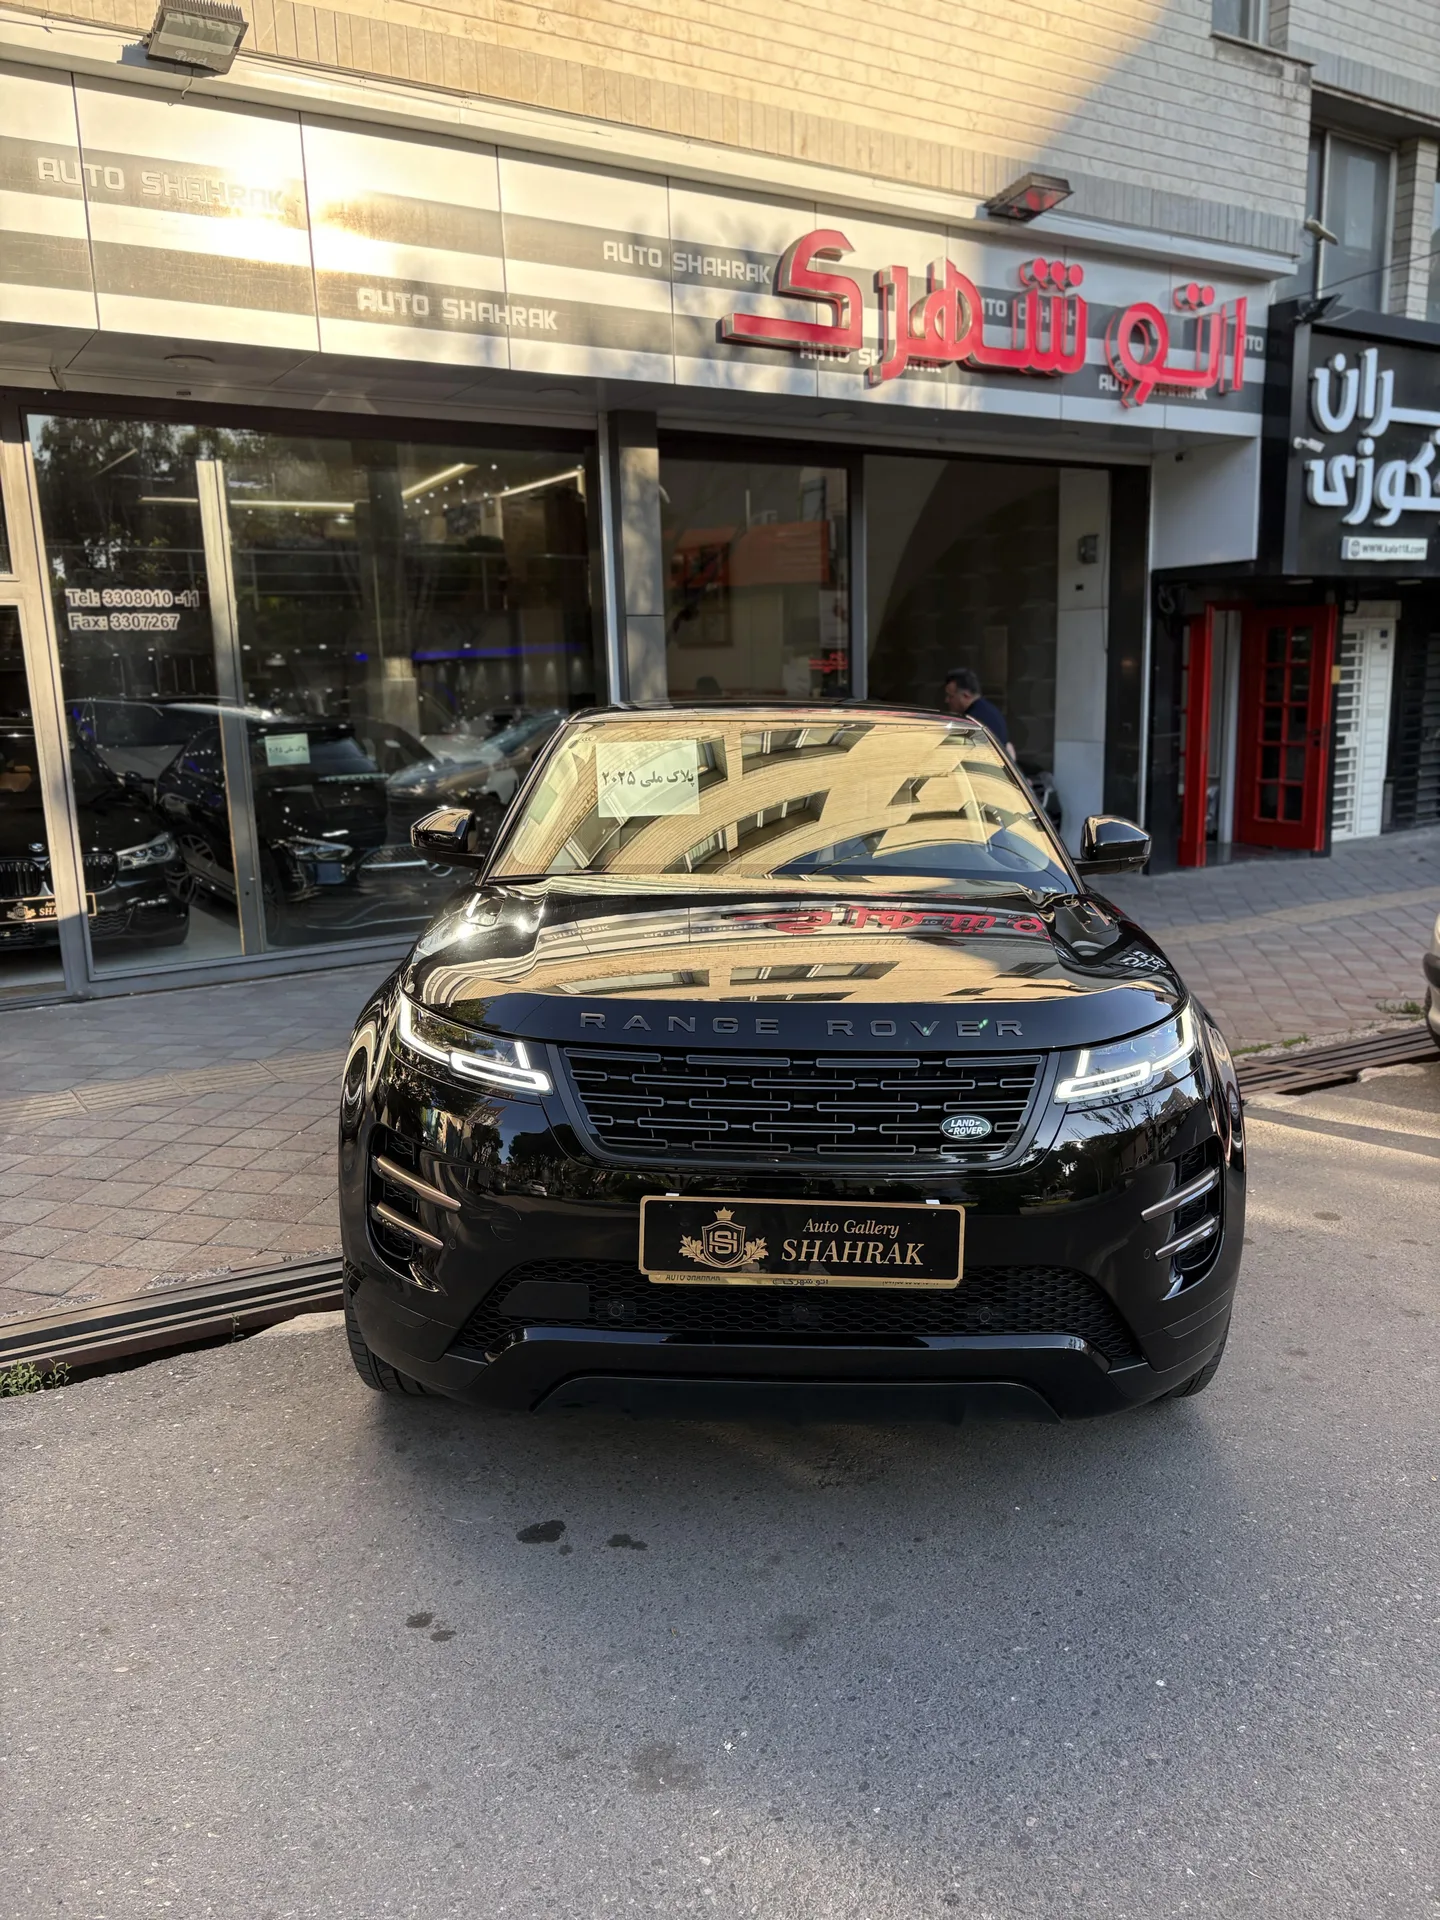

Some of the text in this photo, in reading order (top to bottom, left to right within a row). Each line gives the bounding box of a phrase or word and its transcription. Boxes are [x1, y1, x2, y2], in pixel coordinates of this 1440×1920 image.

[37, 156, 126, 191] AUTO
[602, 240, 772, 285] AUTO SHAHRAK
[356, 287, 559, 331] AUTO SHAHRAK
[718, 228, 1247, 409] اتو شهرک
[65, 588, 101, 607] Tel:
[102, 589, 173, 608] 3308010
[68, 612, 180, 631] Fax: 3307267
[601, 769, 695, 788] پلاک ملی ۲۰۲۵
[579, 1012, 1024, 1038] RANGE ROVER
[950, 1119, 975, 1128] LAND
[953, 1126, 983, 1135] ROVER
[802, 1218, 900, 1239] Auto Gallery
[781, 1238, 925, 1266] SHAHRAK
